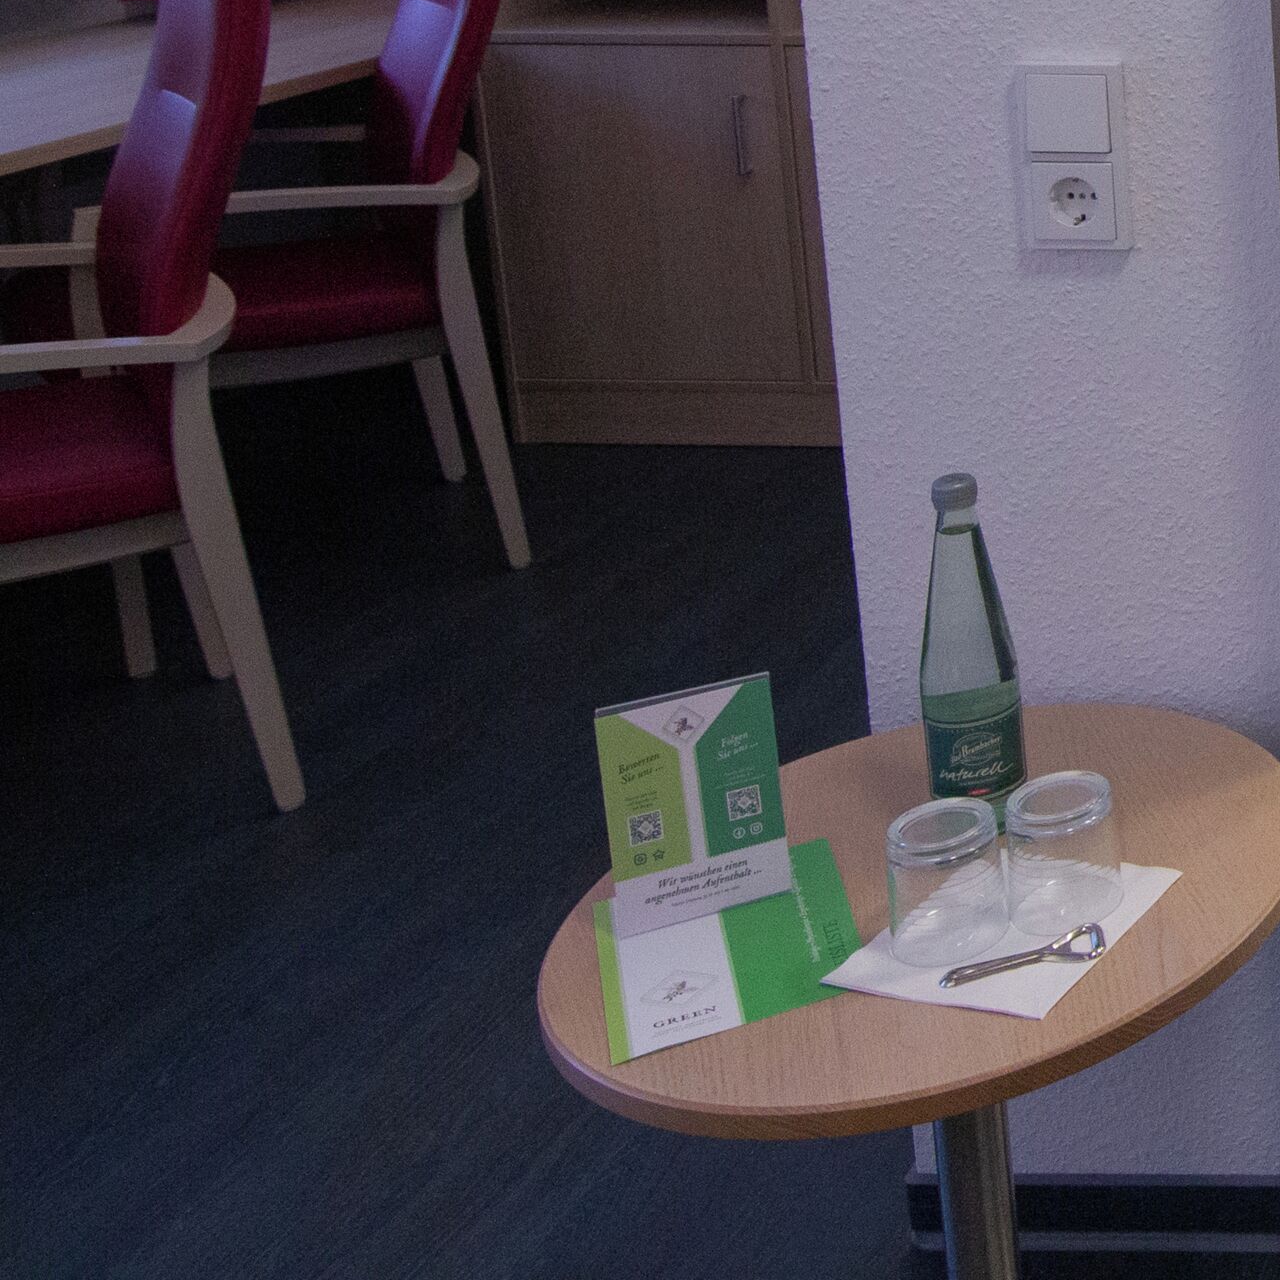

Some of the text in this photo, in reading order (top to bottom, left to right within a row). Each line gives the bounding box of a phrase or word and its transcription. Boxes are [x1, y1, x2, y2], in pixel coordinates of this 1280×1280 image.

[939, 760, 1014, 782] naturell
[644, 884, 700, 905] angenehmen
[702, 868, 752, 890] Aufenthalt
[657, 859, 749, 889] Wir wünschen einen
[652, 1005, 716, 1029] GREEN
